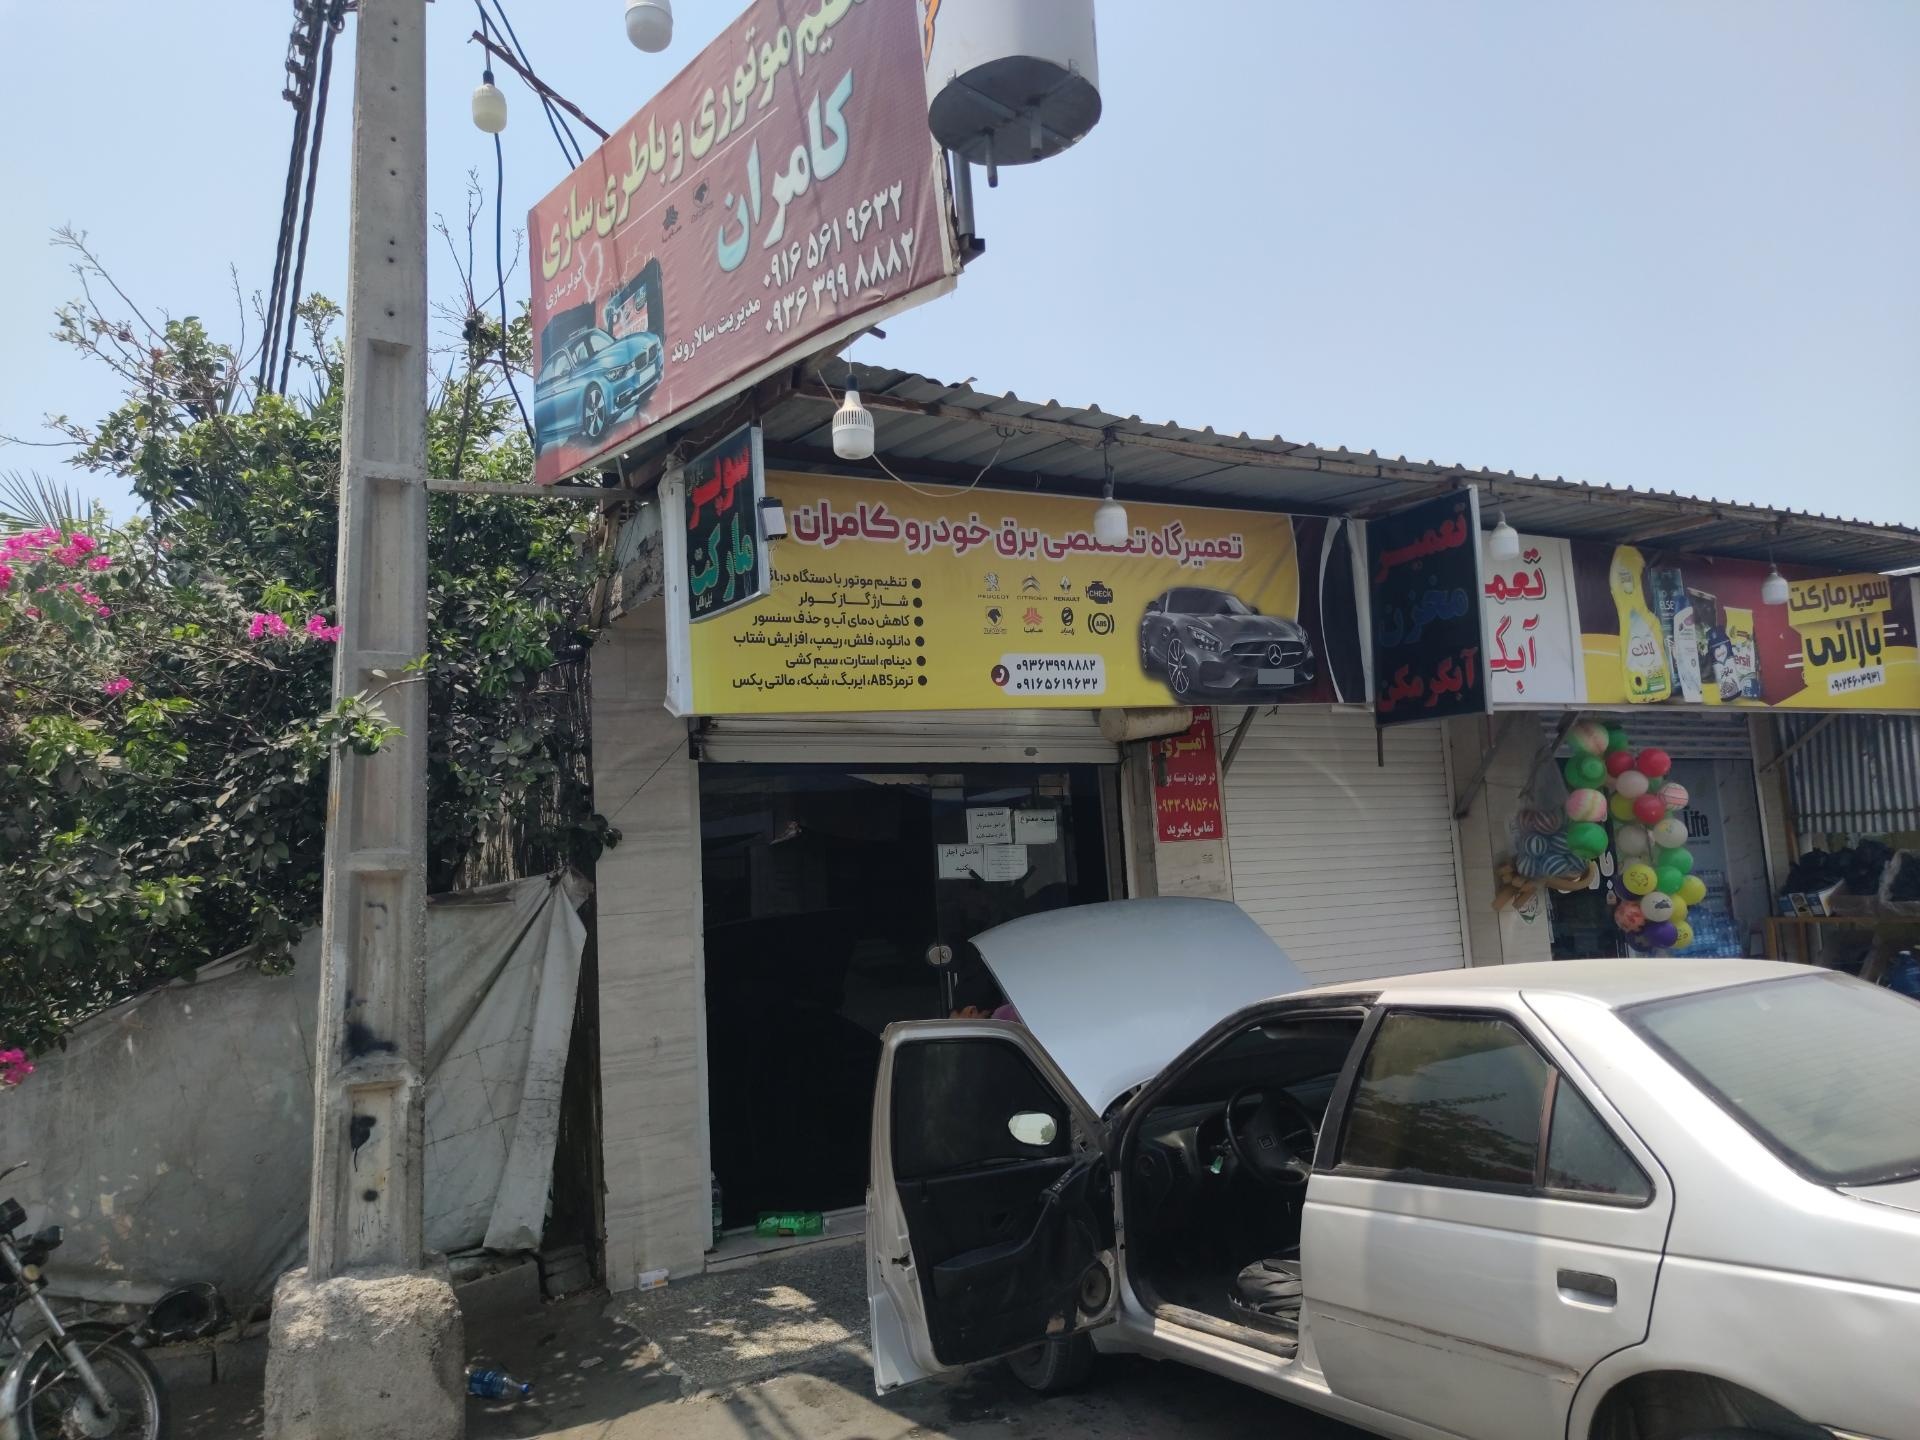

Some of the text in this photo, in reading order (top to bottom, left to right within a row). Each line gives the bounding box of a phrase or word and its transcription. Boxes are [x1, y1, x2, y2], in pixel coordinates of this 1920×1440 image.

[690, 25, 793, 160] موتوری
[596, 112, 668, 239] باطری
[717, 68, 853, 272] کامران
[542, 185, 594, 281] سازی
[763, 180, 902, 287] ۰۹۱۶ ۵۶۱ ۹۶۳۲
[765, 227, 913, 333] ۰۹۳۶ ۳۹۹ ۸۸۸۲
[717, 299, 760, 334] مدیریت
[689, 446, 751, 530] سوپر
[794, 503, 900, 546] کامران
[906, 515, 990, 553] خودرو
[996, 520, 1037, 558] برق
[1152, 523, 1242, 566] تعمیرگاه
[1375, 503, 1468, 583] تعمیر
[690, 512, 754, 602] مارکت
[793, 569, 832, 584] دستگاه
[833, 573, 842, 586] با
[843, 576, 873, 589] موتور
[875, 575, 908, 590] تنظیم
[1485, 547, 1547, 604] تعم
[798, 592, 909, 610] شارژ گاز کولر
[1089, 590, 1112, 598] CHECK
[752, 613, 791, 626] سنسور
[794, 610, 821, 625] حذف
[832, 612, 846, 629] آب
[848, 614, 875, 628] دمای
[876, 614, 910, 628] کاهش
[734, 630, 765, 647] شتاب
[767, 632, 808, 648] افزایش
[1805, 618, 1882, 669] بارانی
[785, 652, 811, 668] کشی
[814, 657, 838, 669] سیم
[1734, 655, 1751, 668] ersil
[765, 673, 795, 689] مالتی
[1167, 820, 1215, 837] تماس بگیرید
